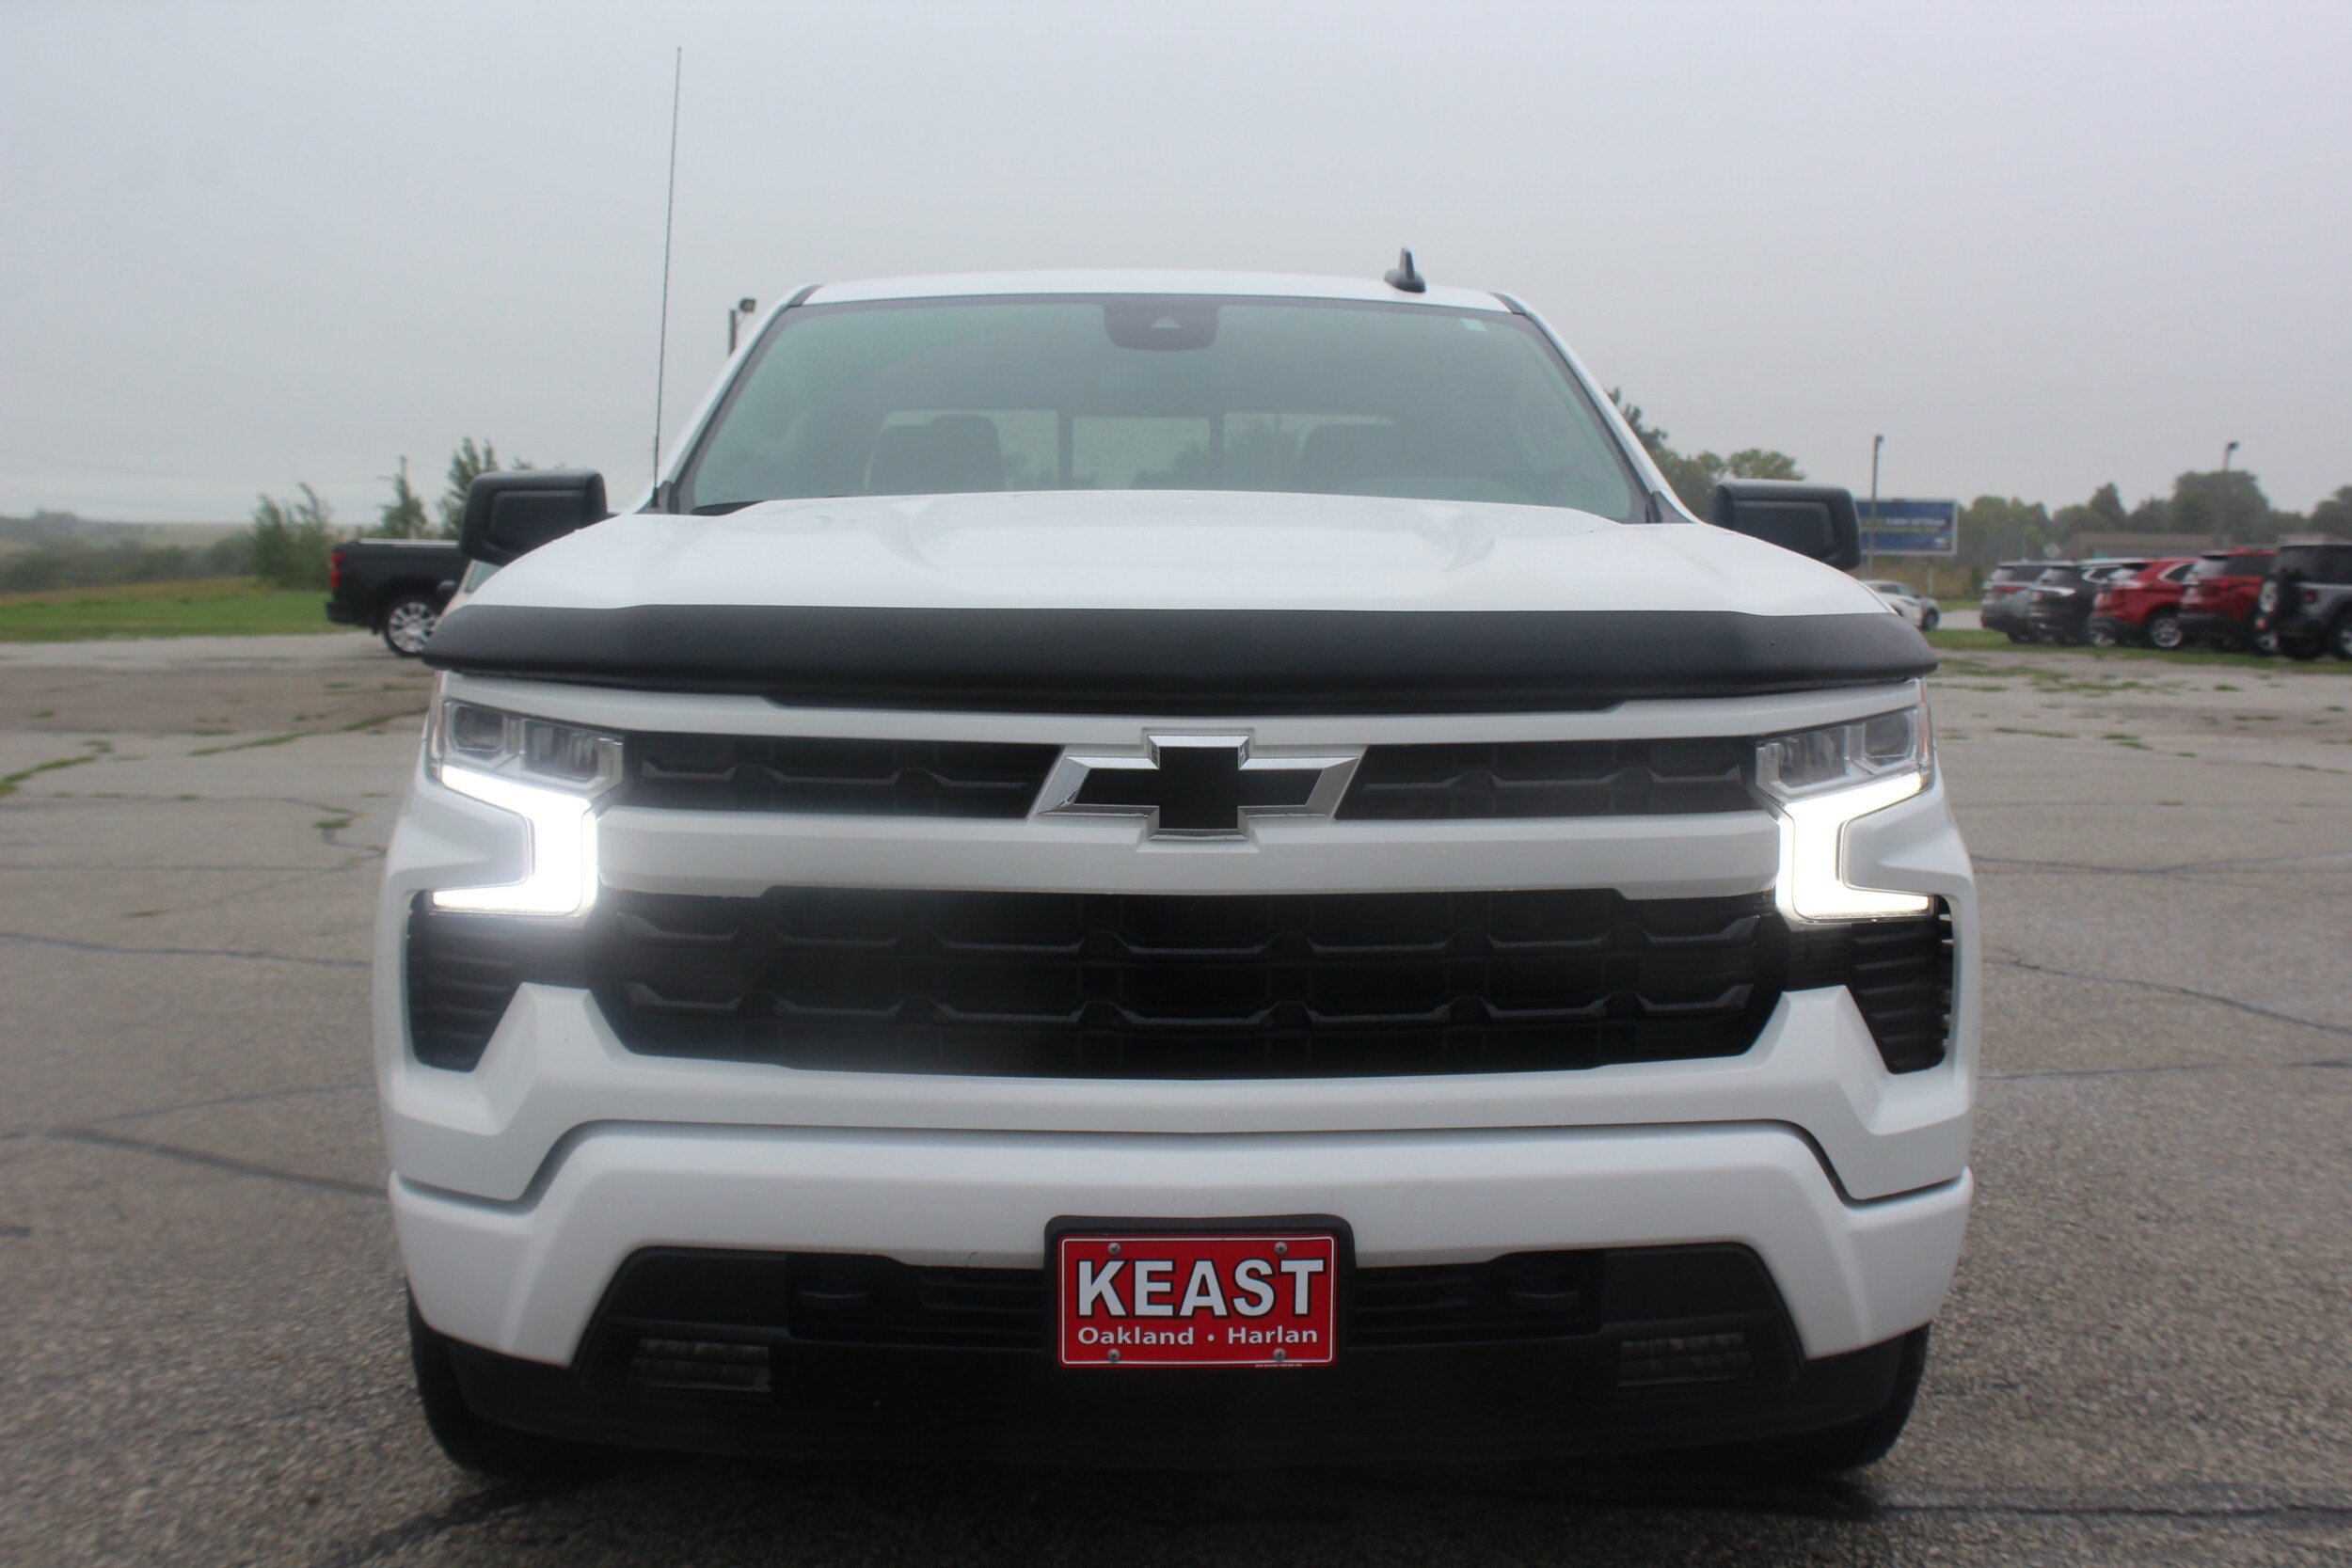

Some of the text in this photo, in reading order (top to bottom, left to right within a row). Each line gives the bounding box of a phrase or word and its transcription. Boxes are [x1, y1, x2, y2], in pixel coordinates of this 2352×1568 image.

[1078, 1259, 1324, 1317] KEAST
[1078, 1325, 1318, 1345] Oakland Harlan
